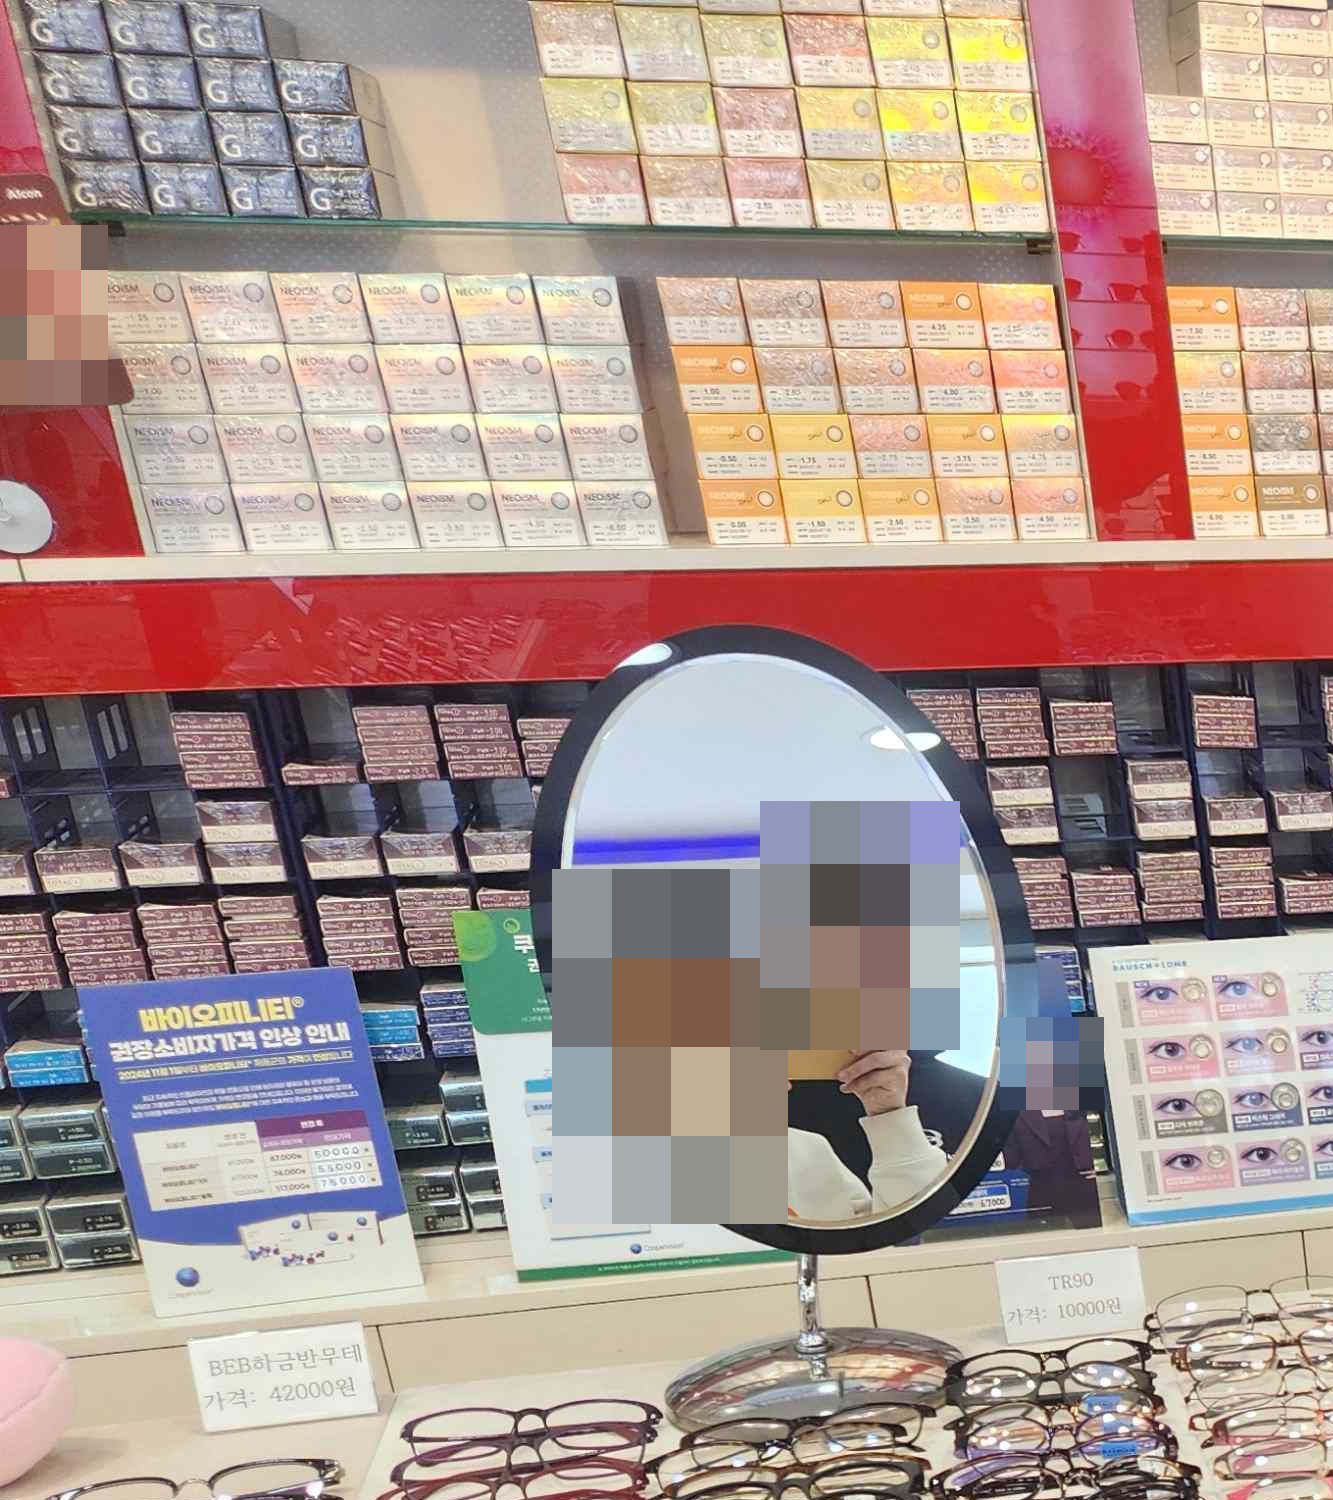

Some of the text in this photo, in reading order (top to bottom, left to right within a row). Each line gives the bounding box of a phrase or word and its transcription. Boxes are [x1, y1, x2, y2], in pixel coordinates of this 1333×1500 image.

[7, 186, 43, 200] Alcon
[108, 1021, 352, 1064] 권장소비자가격 인상 안내
[1046, 1271, 1095, 1292] TR90
[1006, 1296, 1123, 1327] 가격: 10000원
[207, 1342, 364, 1378] BEB하금반무테
[203, 1376, 358, 1412] 가격: 42000원
